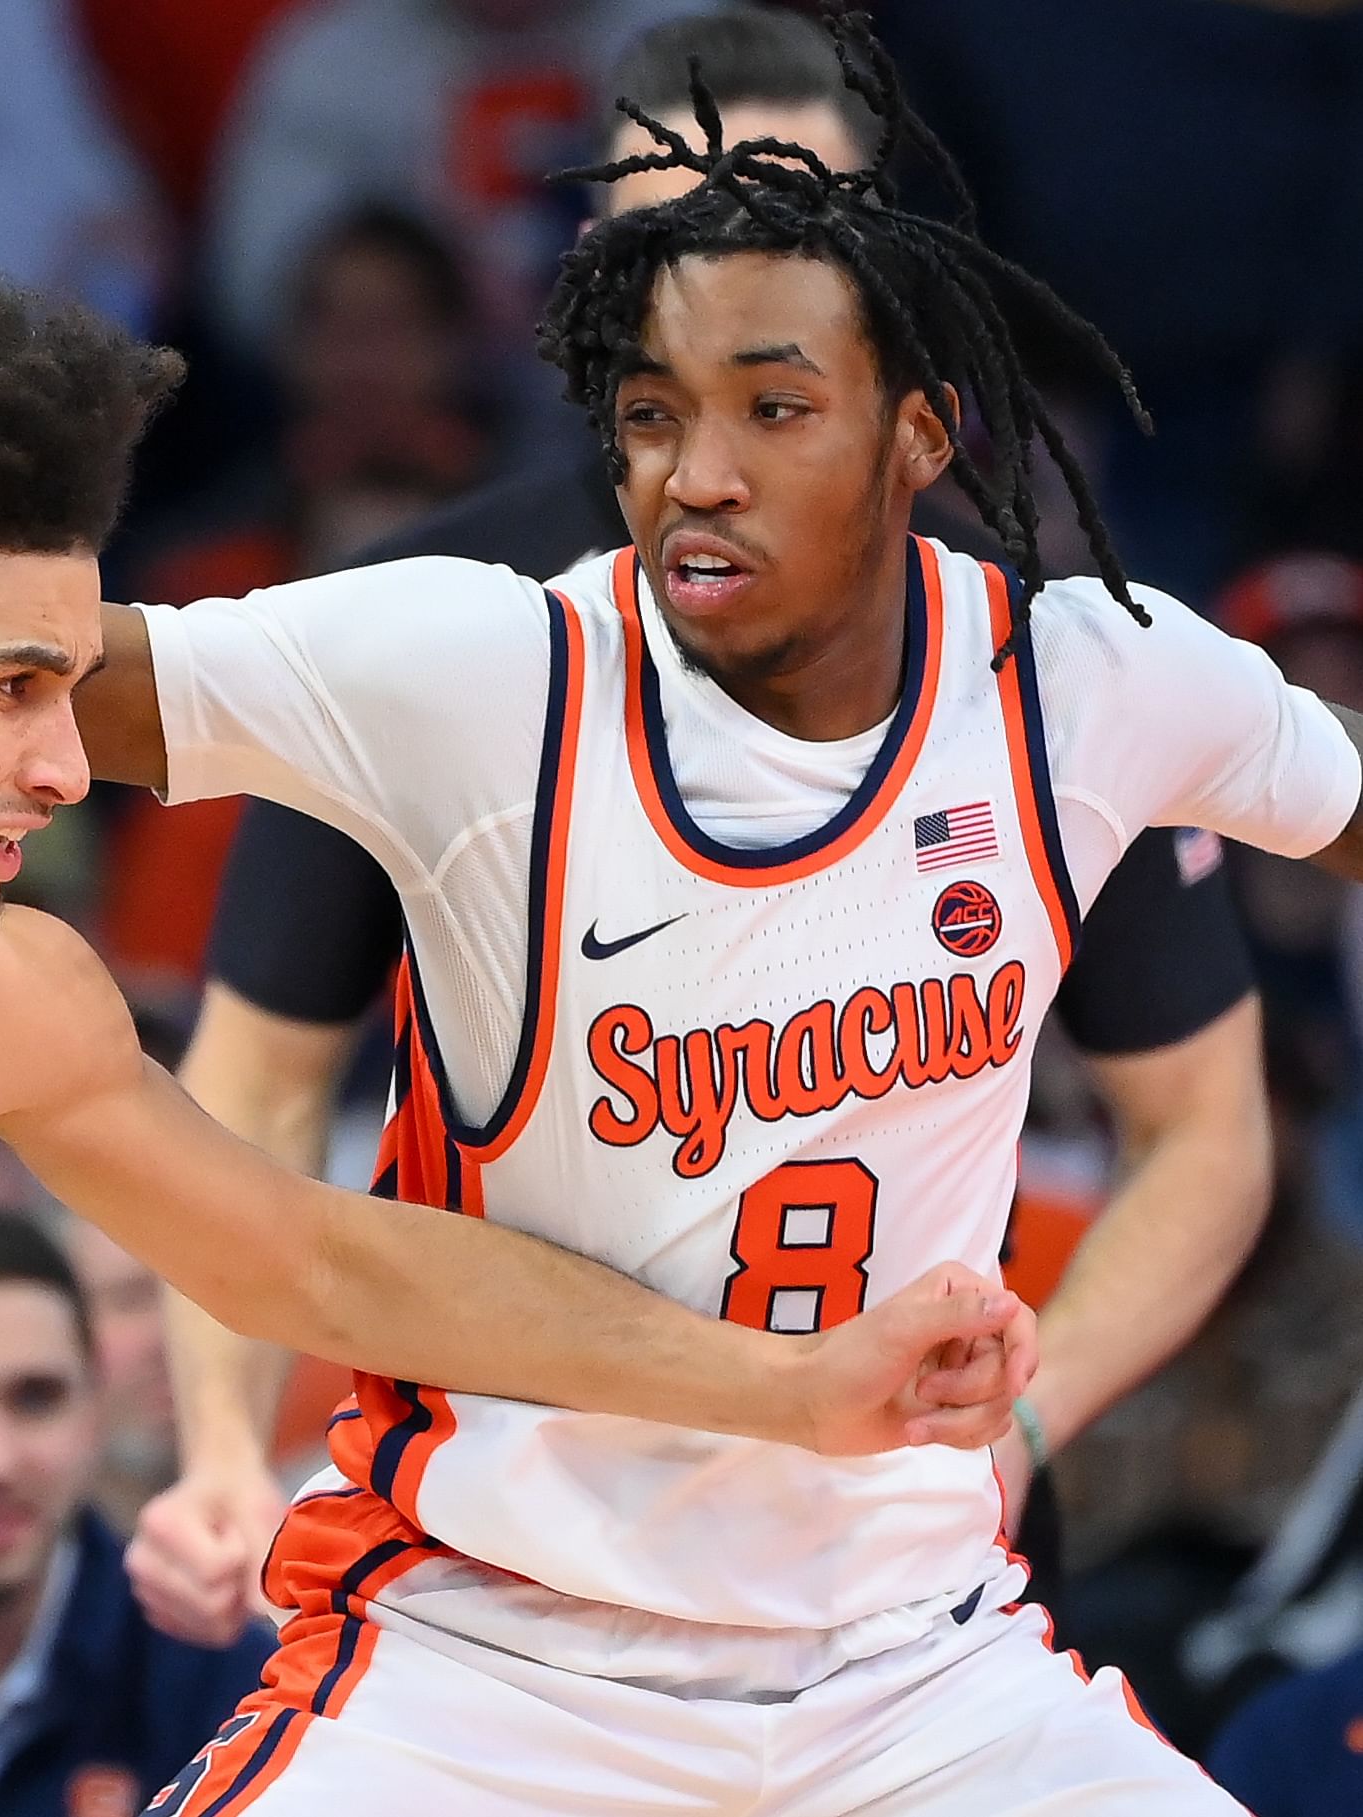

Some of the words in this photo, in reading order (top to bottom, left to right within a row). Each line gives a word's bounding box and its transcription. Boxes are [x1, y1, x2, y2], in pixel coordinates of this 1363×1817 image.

[944, 902, 994, 925] ACC
[587, 961, 1026, 1179] Syracuse
[719, 1157, 879, 1336] 8
